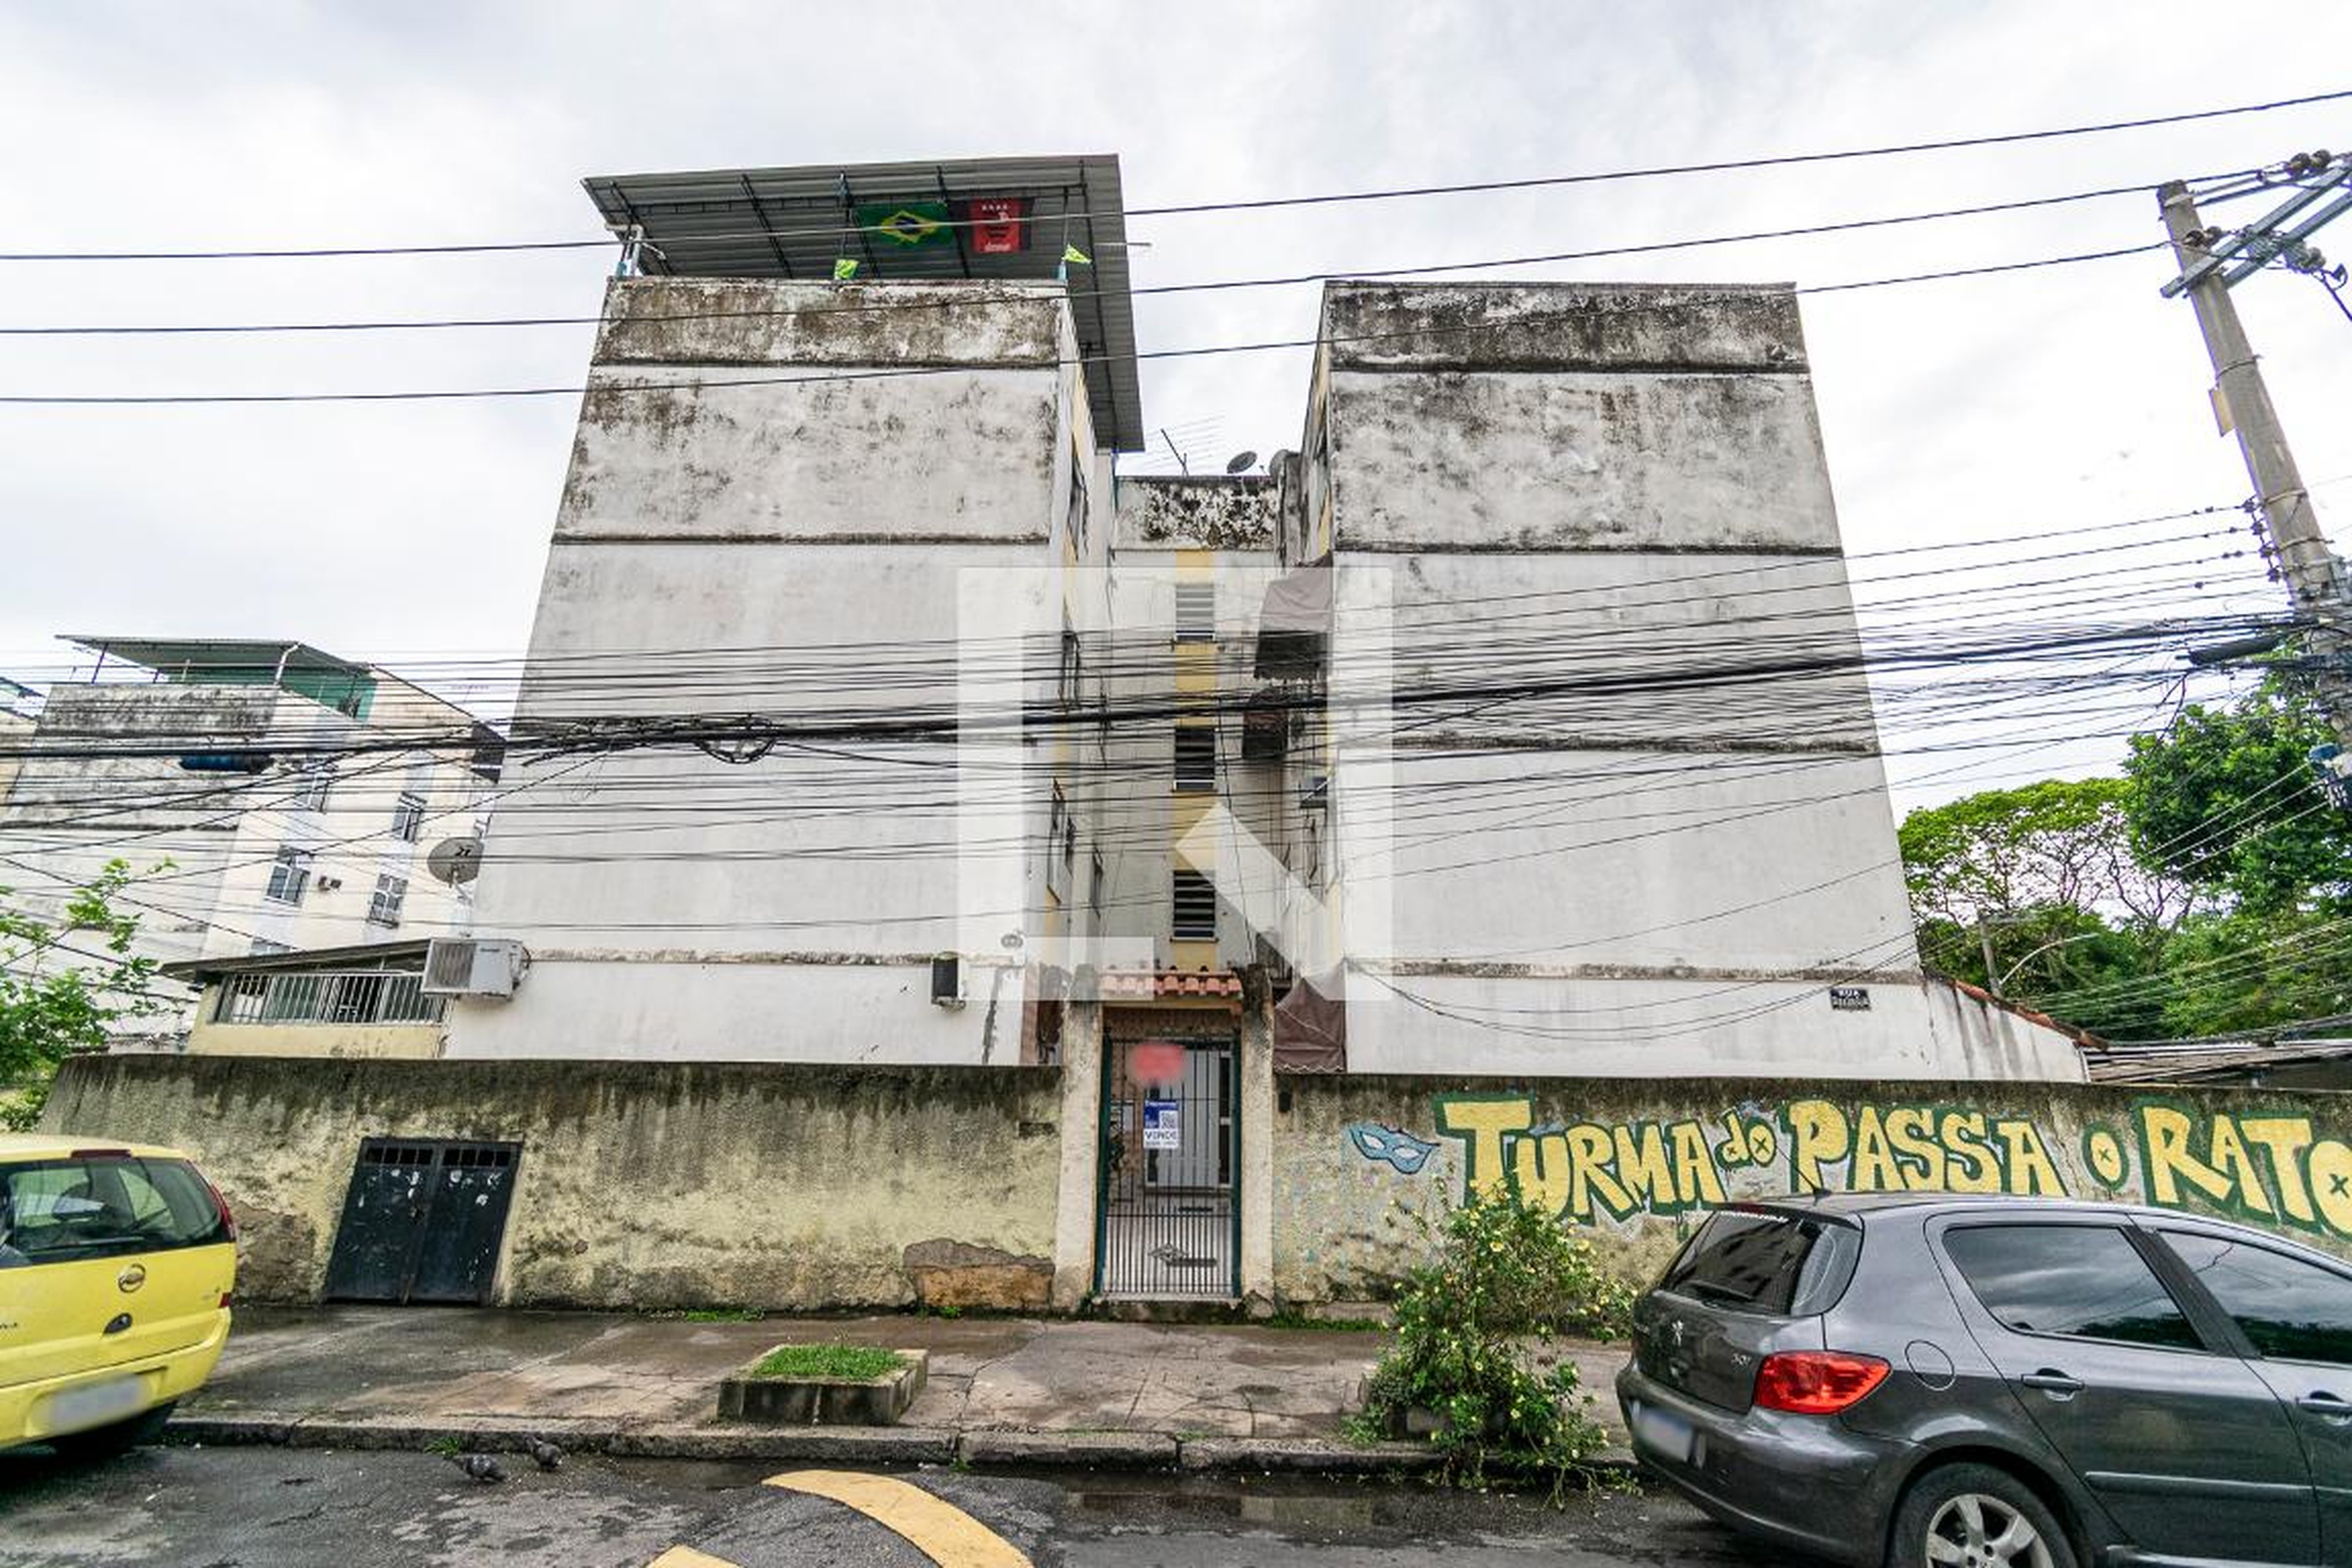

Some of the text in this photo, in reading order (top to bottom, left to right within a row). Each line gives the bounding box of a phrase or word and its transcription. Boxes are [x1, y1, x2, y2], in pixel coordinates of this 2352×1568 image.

[1435, 1096, 1728, 1226] TURMA
[1784, 1096, 2070, 1198] PASSA
[2134, 1098, 2352, 1238] RATO
